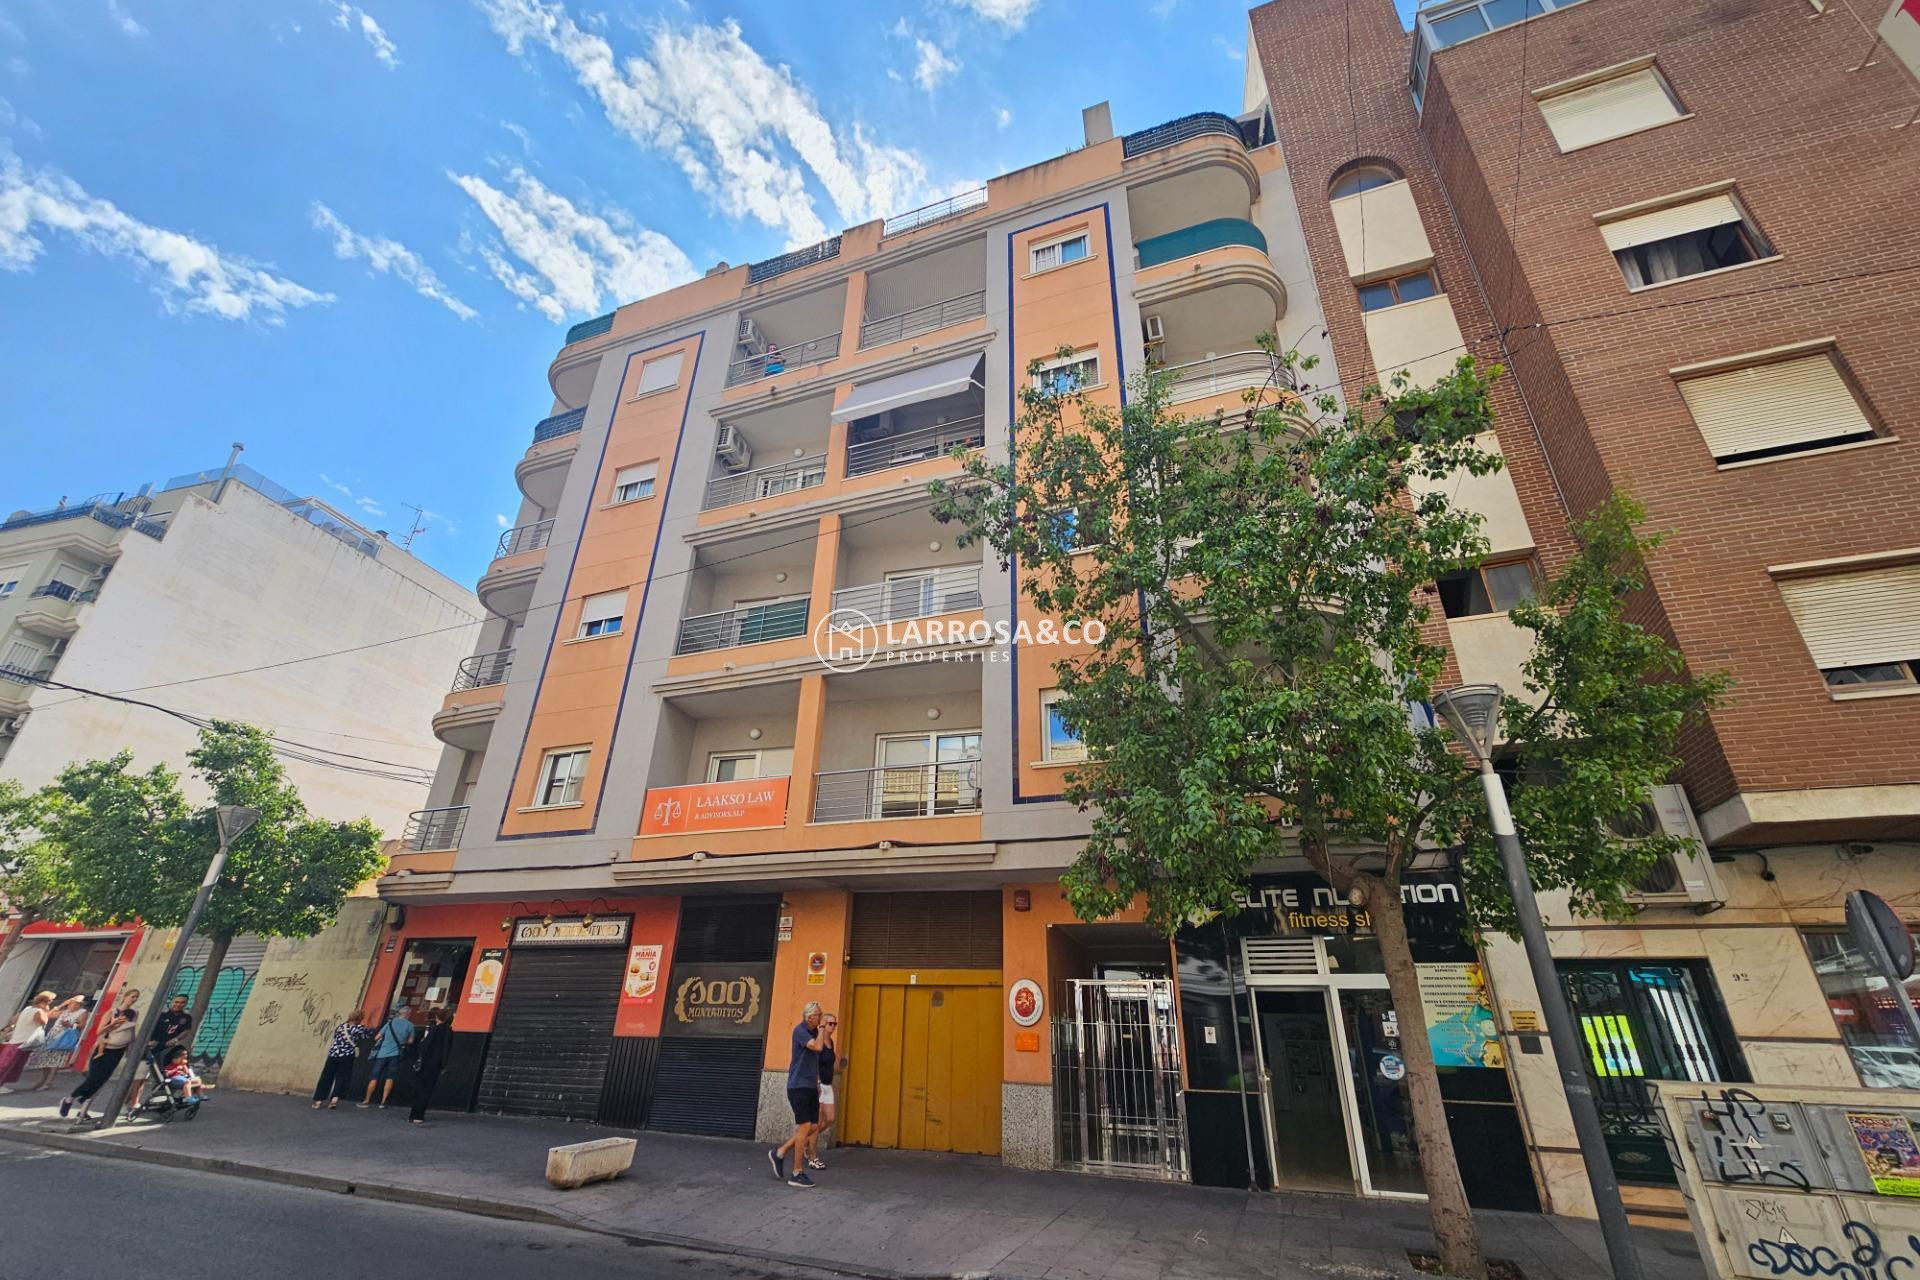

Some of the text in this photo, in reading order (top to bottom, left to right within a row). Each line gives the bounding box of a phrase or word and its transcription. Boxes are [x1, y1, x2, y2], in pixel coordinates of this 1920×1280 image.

[696, 790, 775, 808] LAAKSO LAW
[1231, 889, 1299, 908] ELITE
[1289, 912, 1349, 928] fitness
[690, 981, 747, 1005] 500
[688, 1007, 744, 1018] MONTADITOS
